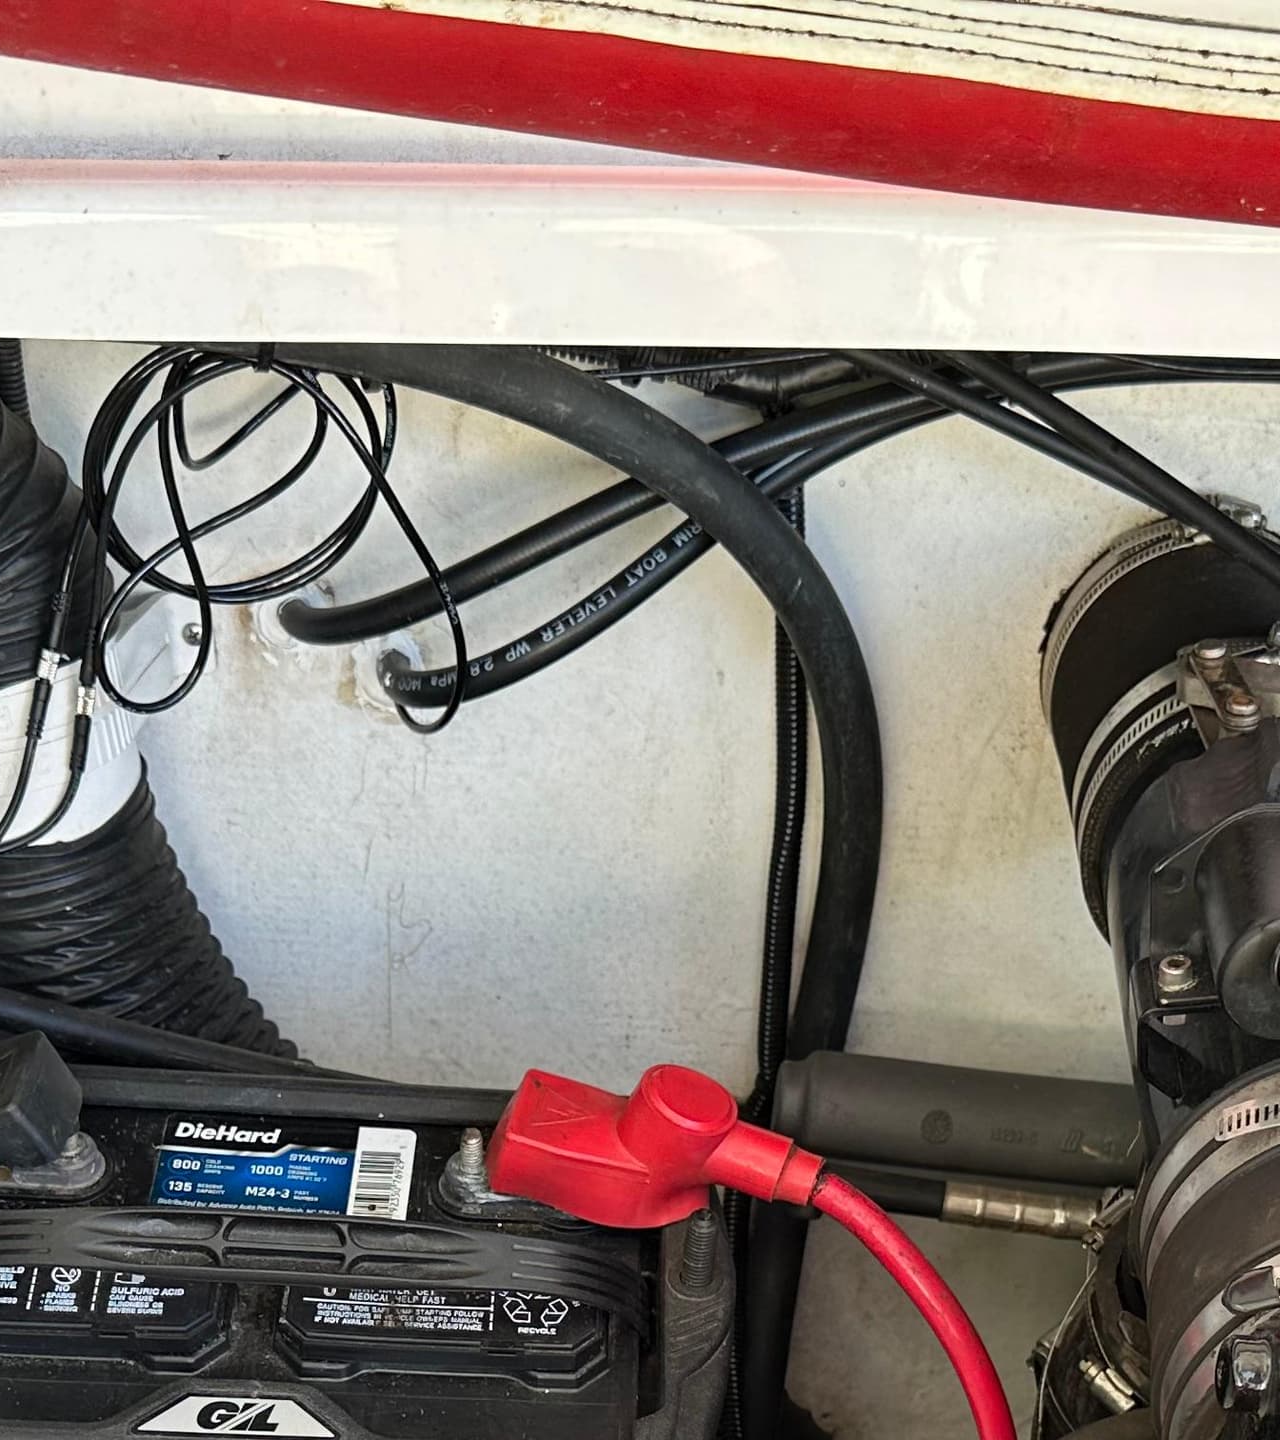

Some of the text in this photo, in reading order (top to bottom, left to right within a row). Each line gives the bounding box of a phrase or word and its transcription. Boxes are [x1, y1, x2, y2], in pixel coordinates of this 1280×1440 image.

[625, 547, 667, 588] BOAT
[540, 586, 618, 643] LEVELER
[505, 640, 531, 663] WP
[174, 1121, 282, 1145] DieHard
[171, 1158, 201, 1171] 800
[288, 1153, 349, 1166] STARTING
[249, 1163, 284, 1176] 1000
[167, 1180, 193, 1193] 135
[245, 1185, 290, 1199] M24-3
[54, 1284, 71, 1293] NO
[110, 1286, 185, 1296] SULFURIC ACID
[349, 1292, 389, 1302] MEDICAL
[421, 1295, 447, 1305] FAST
[415, 1308, 452, 1317] STARTING
[453, 1310, 485, 1318] FOLLOW
[517, 1326, 557, 1335] RECYCLE
